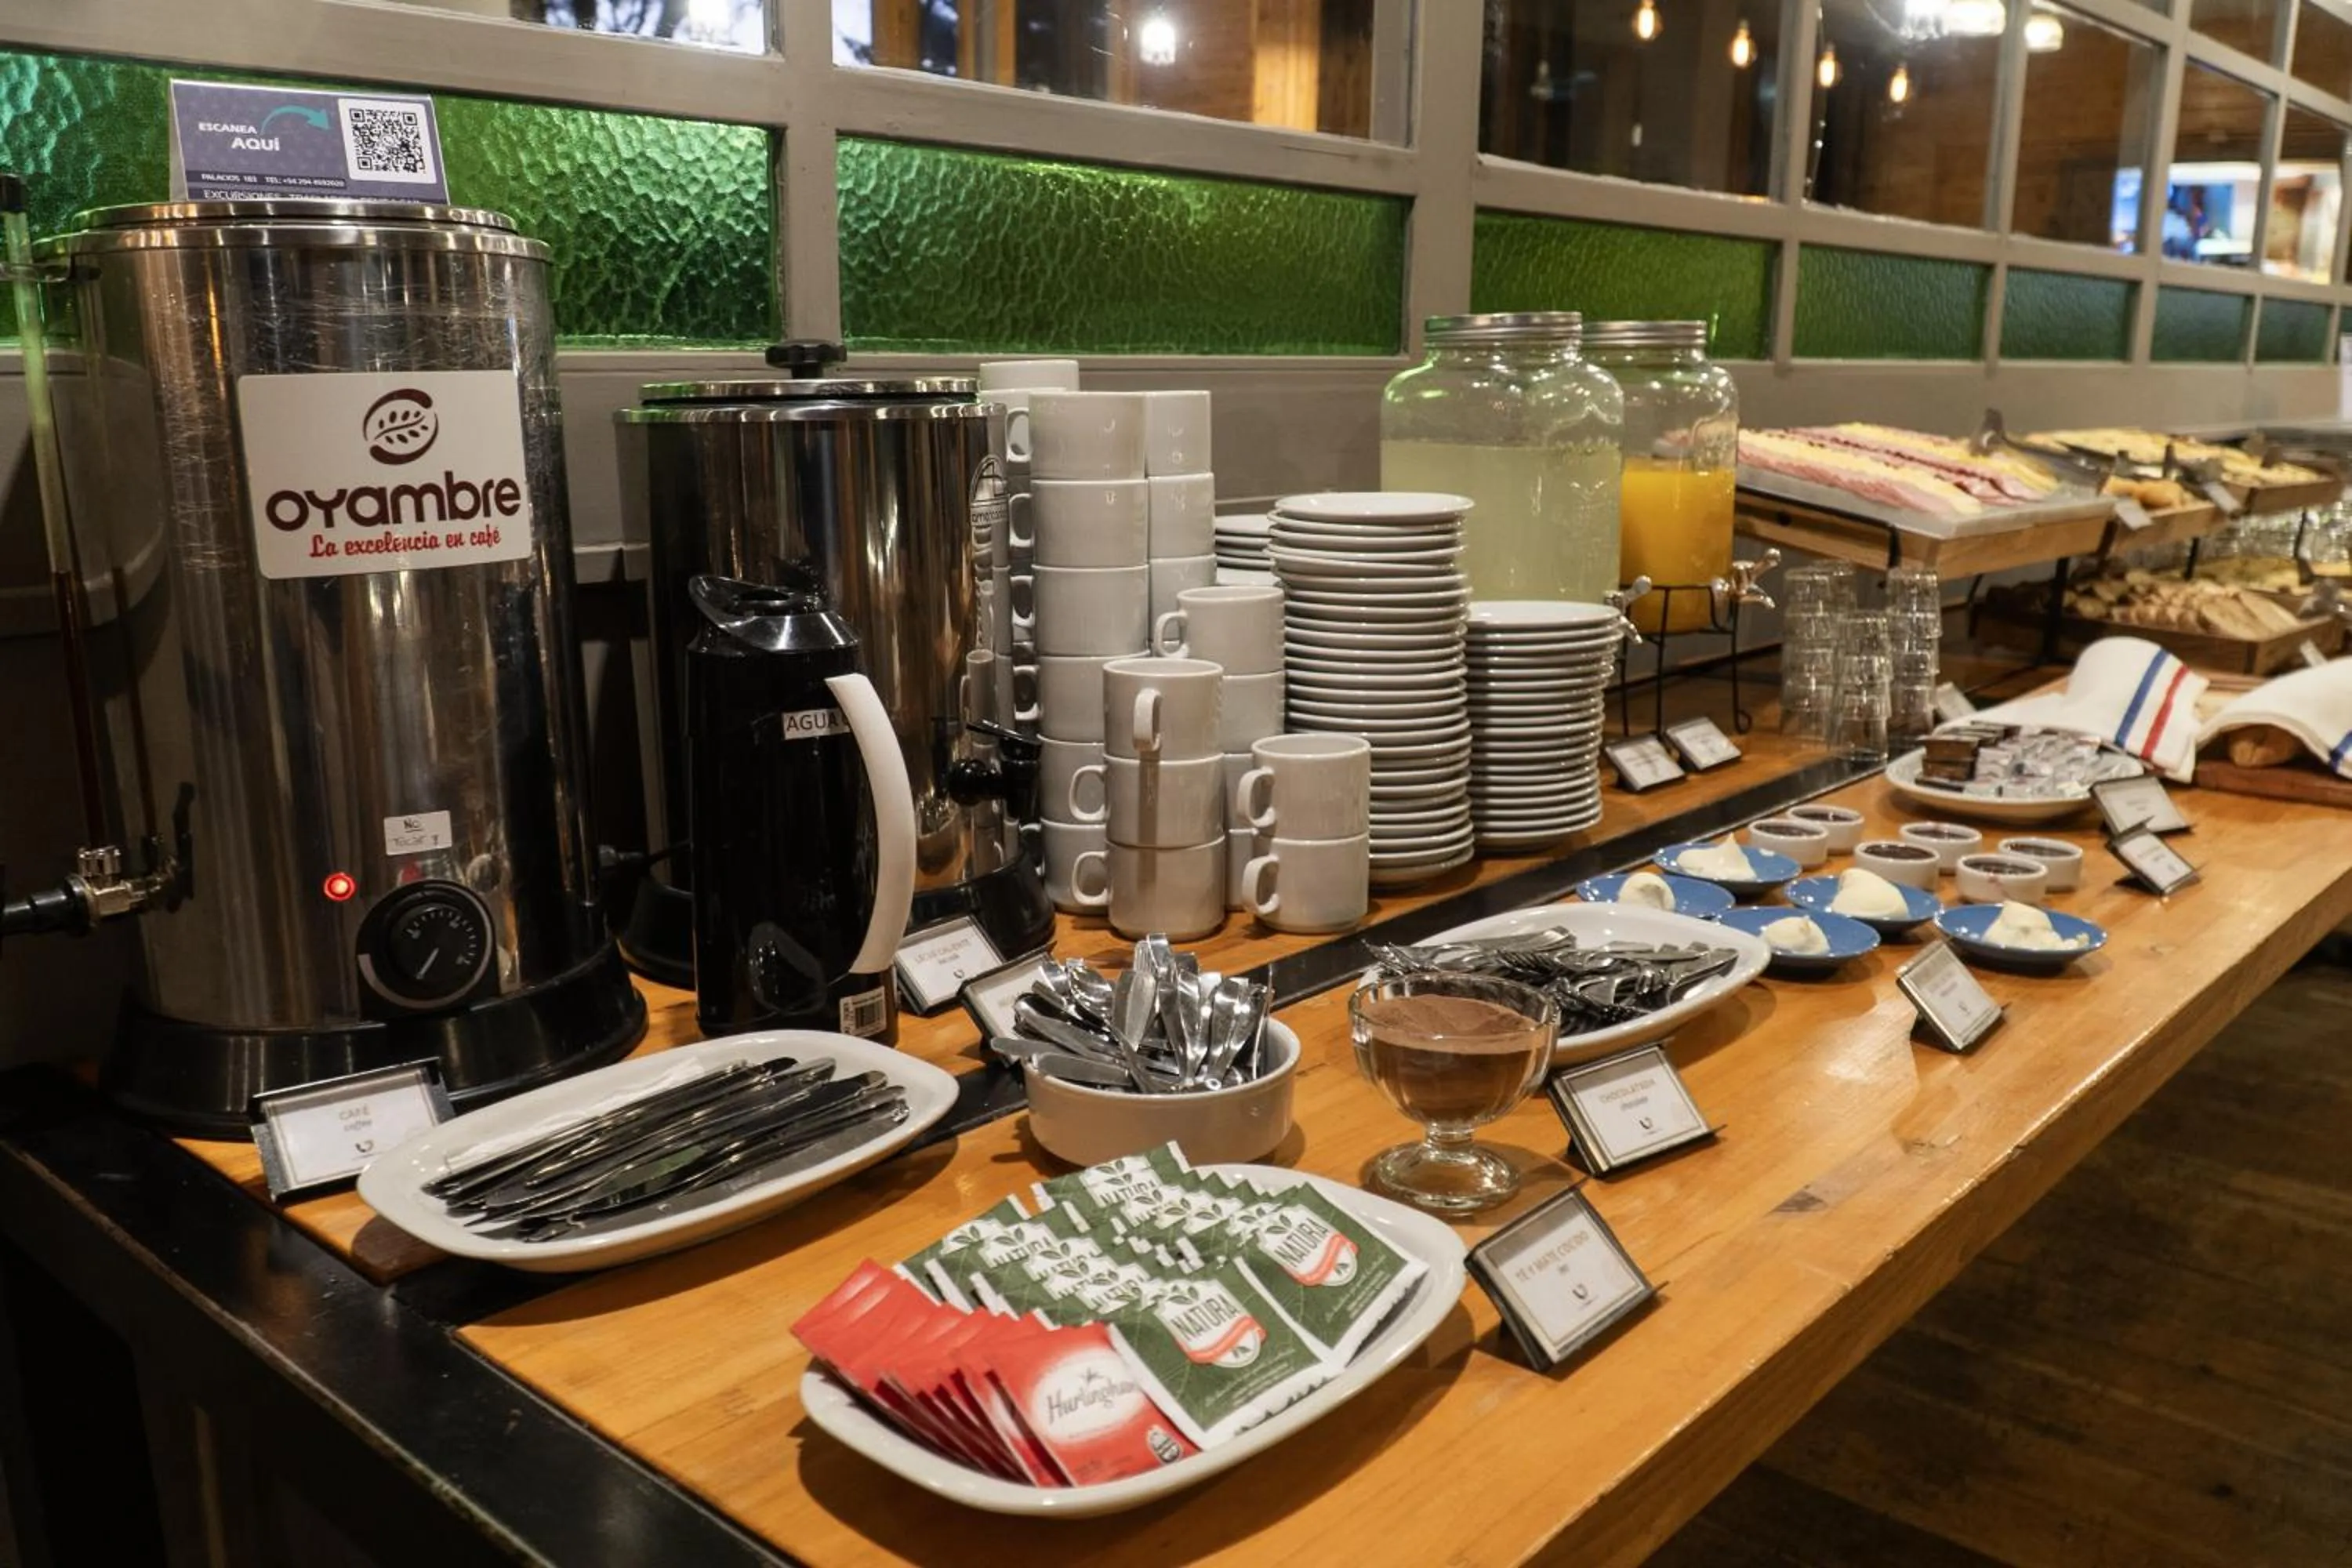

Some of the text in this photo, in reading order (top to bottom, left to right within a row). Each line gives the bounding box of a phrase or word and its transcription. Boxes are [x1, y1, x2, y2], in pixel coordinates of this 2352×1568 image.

[198, 122, 257, 134] ESCANEA
[231, 136, 280, 151] AQUÍ
[309, 524, 502, 558] La excelencia en café
[786, 712, 838, 731] AGUA
[1273, 1217, 1329, 1268] NATURA
[1171, 1294, 1241, 1341] NATURA
